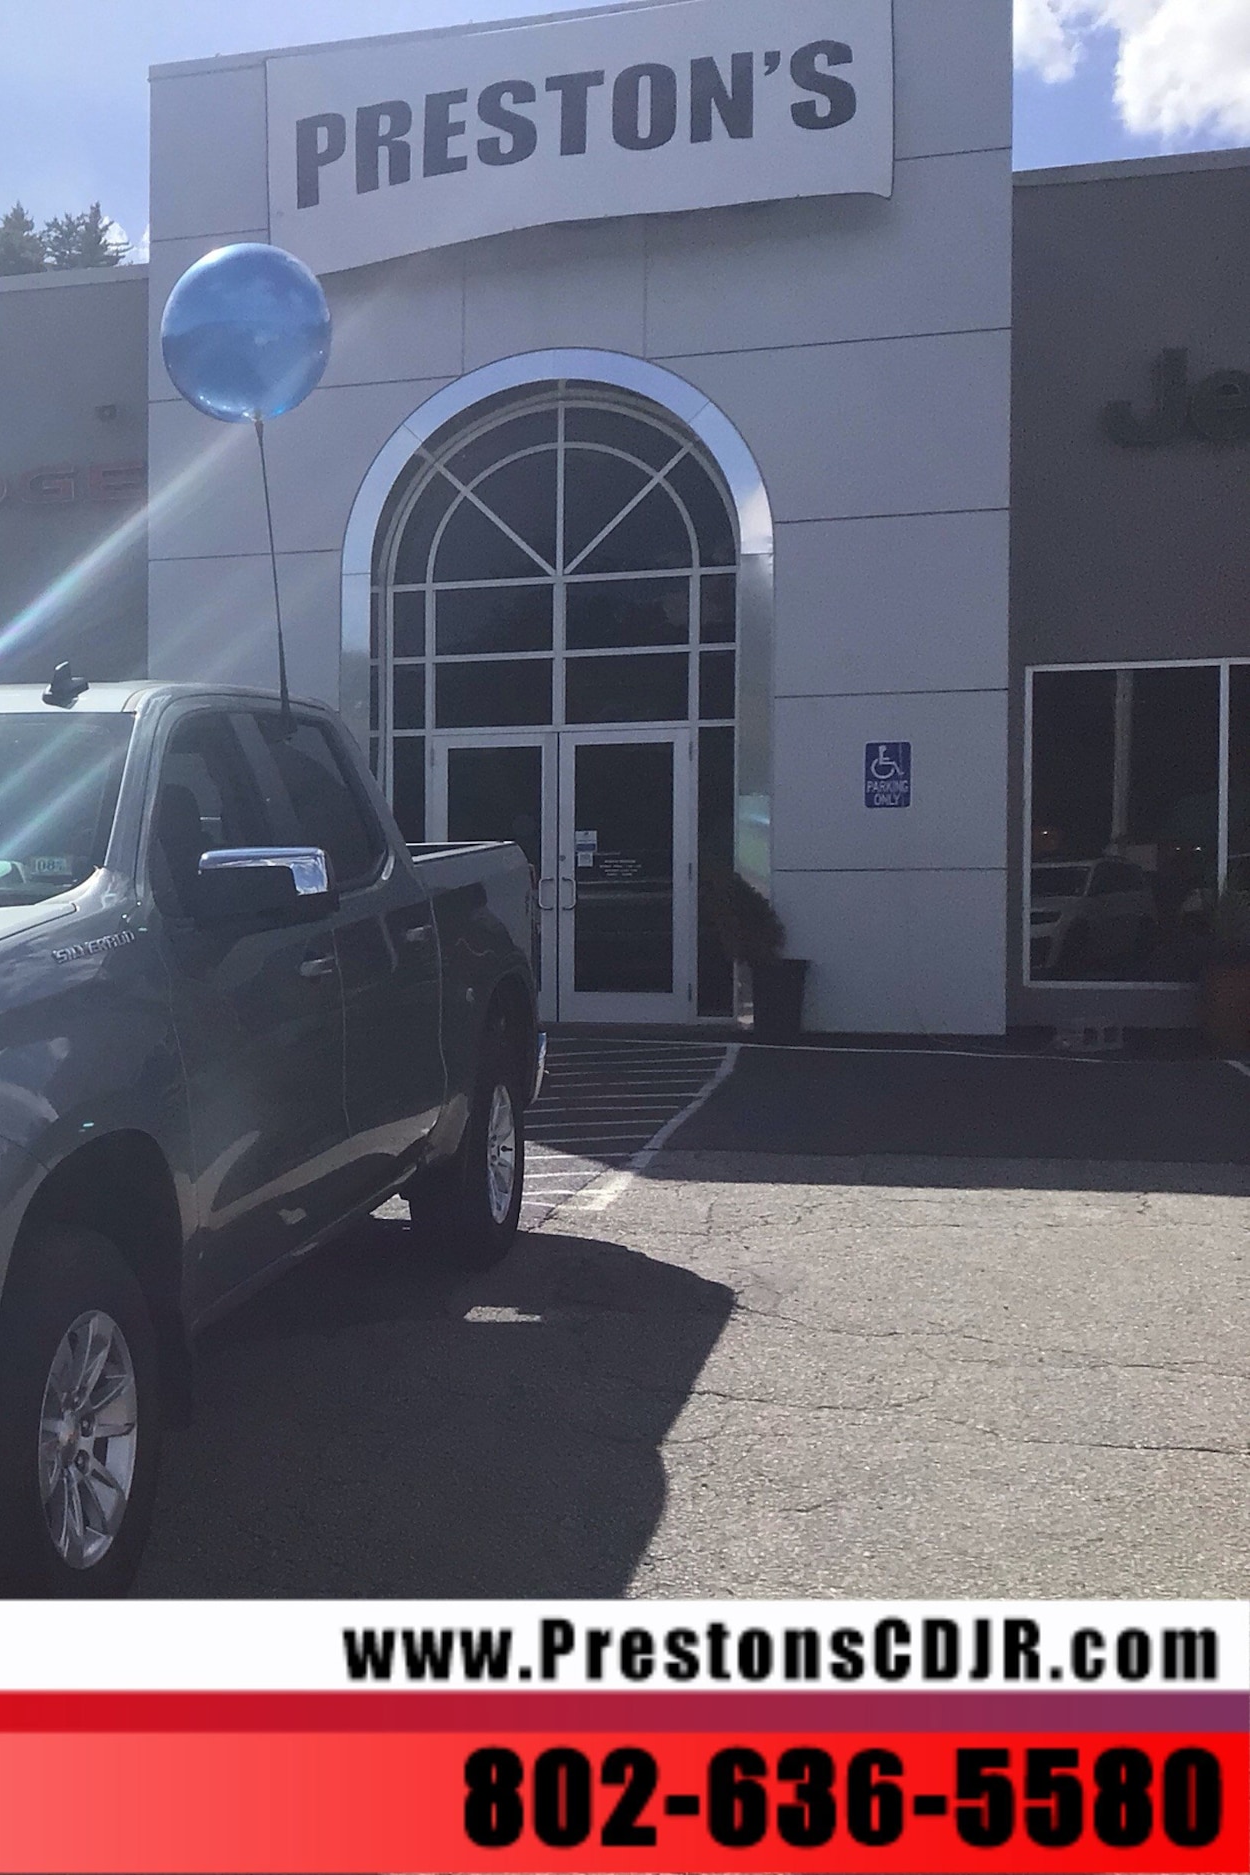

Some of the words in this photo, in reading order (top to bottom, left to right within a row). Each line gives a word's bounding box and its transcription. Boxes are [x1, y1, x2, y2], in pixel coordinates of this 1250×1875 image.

[295, 40, 857, 210] PRESTON'S
[866, 780, 909, 794] PARKING
[874, 793, 902, 806] ONLY
[52, 931, 135, 964] SILVERADO
